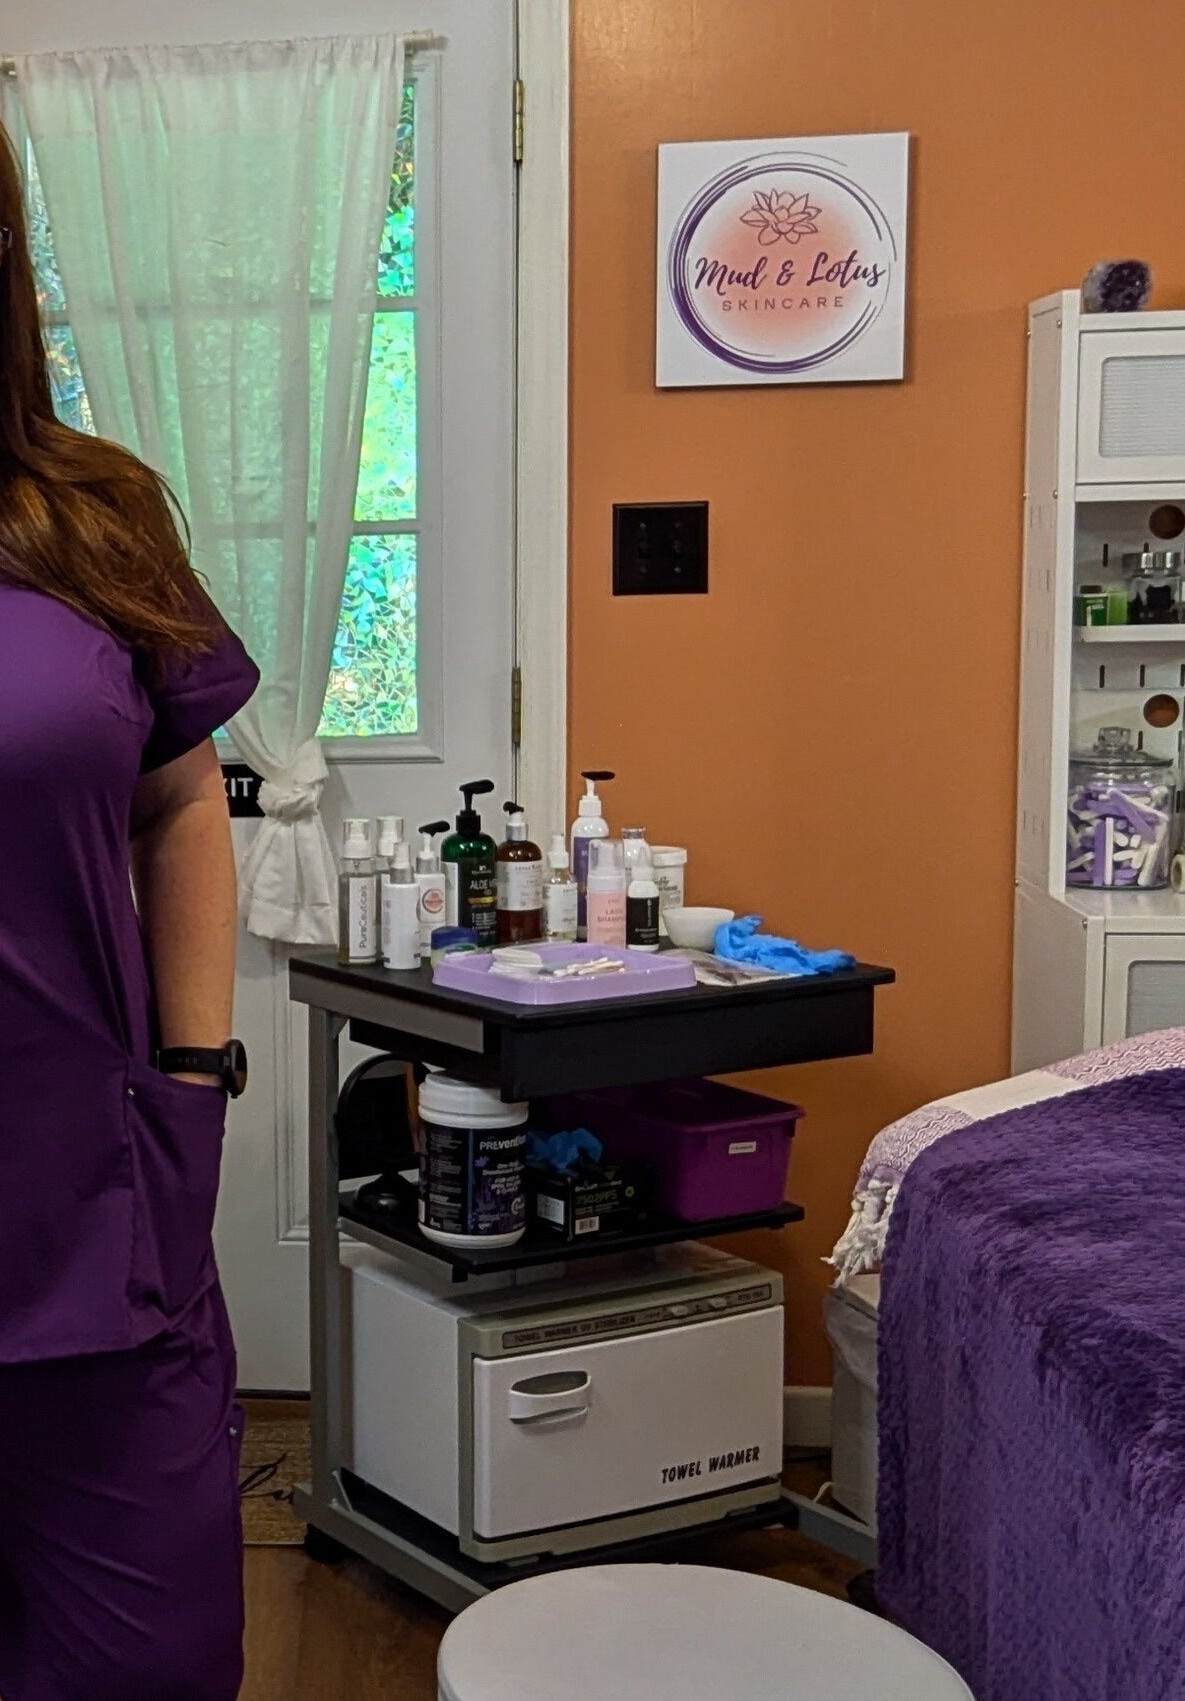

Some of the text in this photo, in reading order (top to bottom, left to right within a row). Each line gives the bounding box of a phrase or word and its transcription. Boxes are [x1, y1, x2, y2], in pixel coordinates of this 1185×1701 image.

[694, 249, 887, 297] Mud & Lotus
[721, 295, 846, 313] SKINCARE
[661, 1446, 761, 1484] TOWEL WARMER
